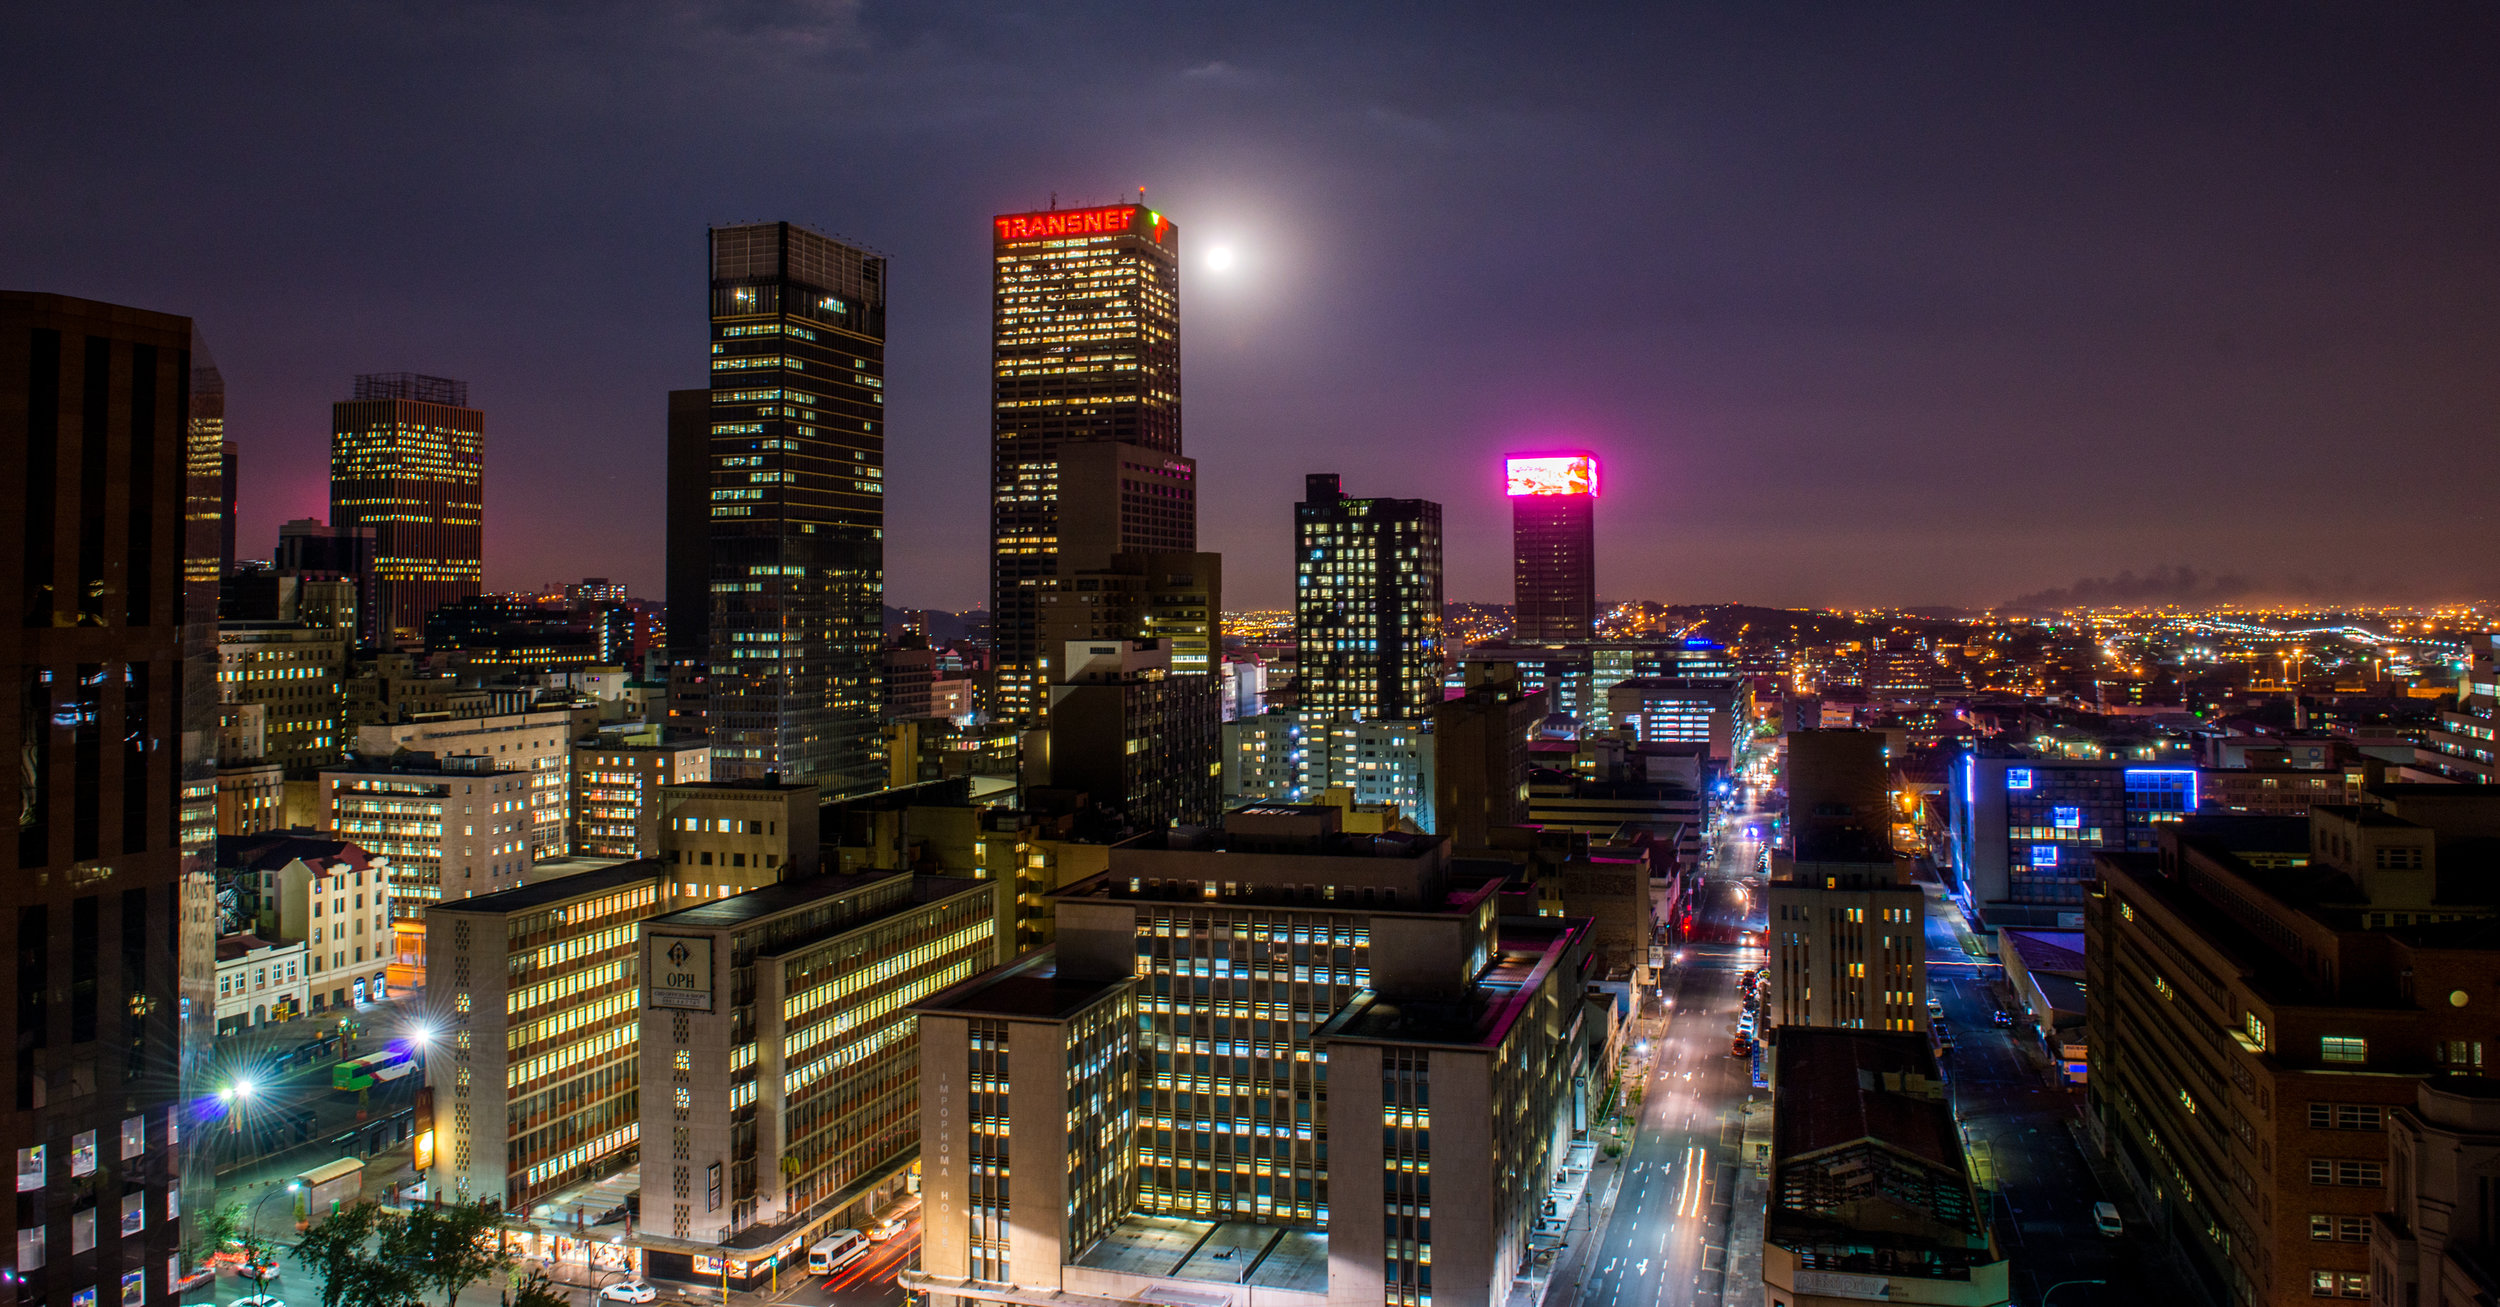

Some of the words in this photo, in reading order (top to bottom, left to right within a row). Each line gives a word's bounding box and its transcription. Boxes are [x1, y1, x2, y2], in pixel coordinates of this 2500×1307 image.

[996, 208, 1135, 238] TRANSNET
[667, 972, 695, 989] OPH
[940, 1072, 949, 1177] IMPOPHOMA
